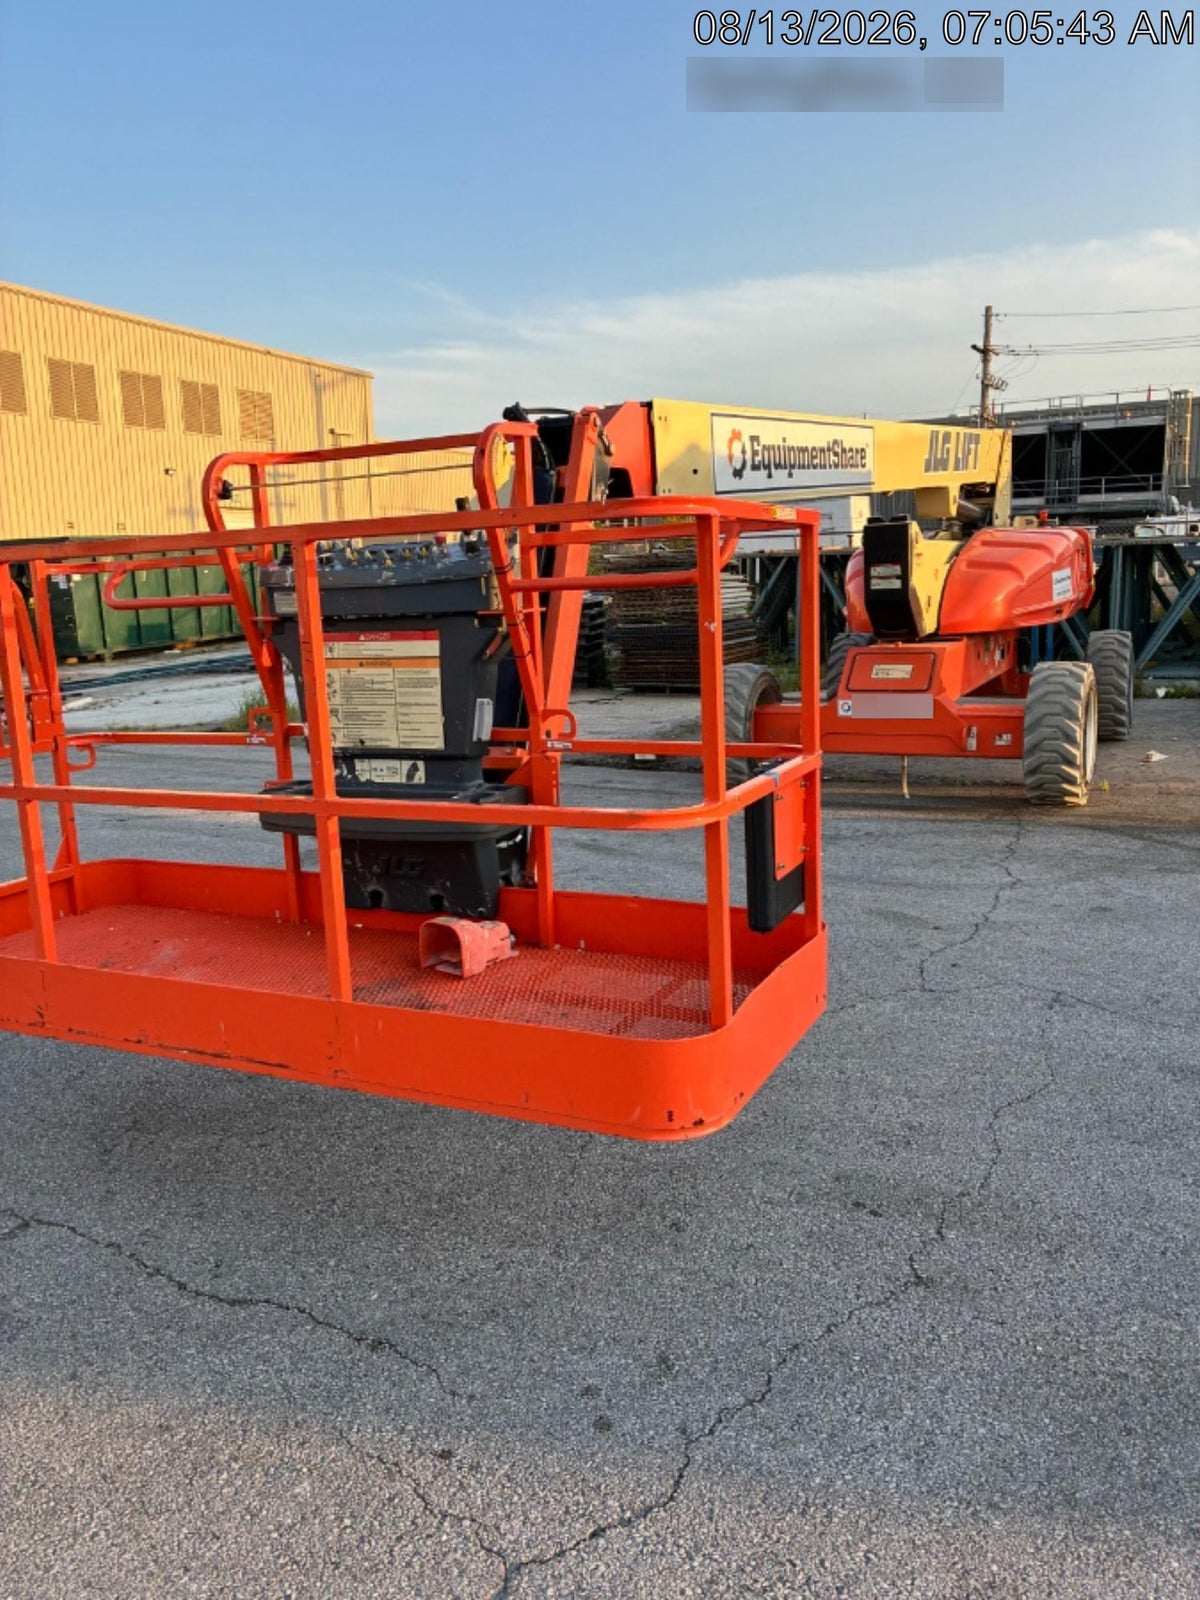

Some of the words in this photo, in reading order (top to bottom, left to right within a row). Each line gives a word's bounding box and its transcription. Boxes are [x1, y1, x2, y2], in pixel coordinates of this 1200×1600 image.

[750, 436, 867, 479] EquipmentShare
[924, 430, 951, 473] JLG
[953, 431, 981, 472] LIFT
